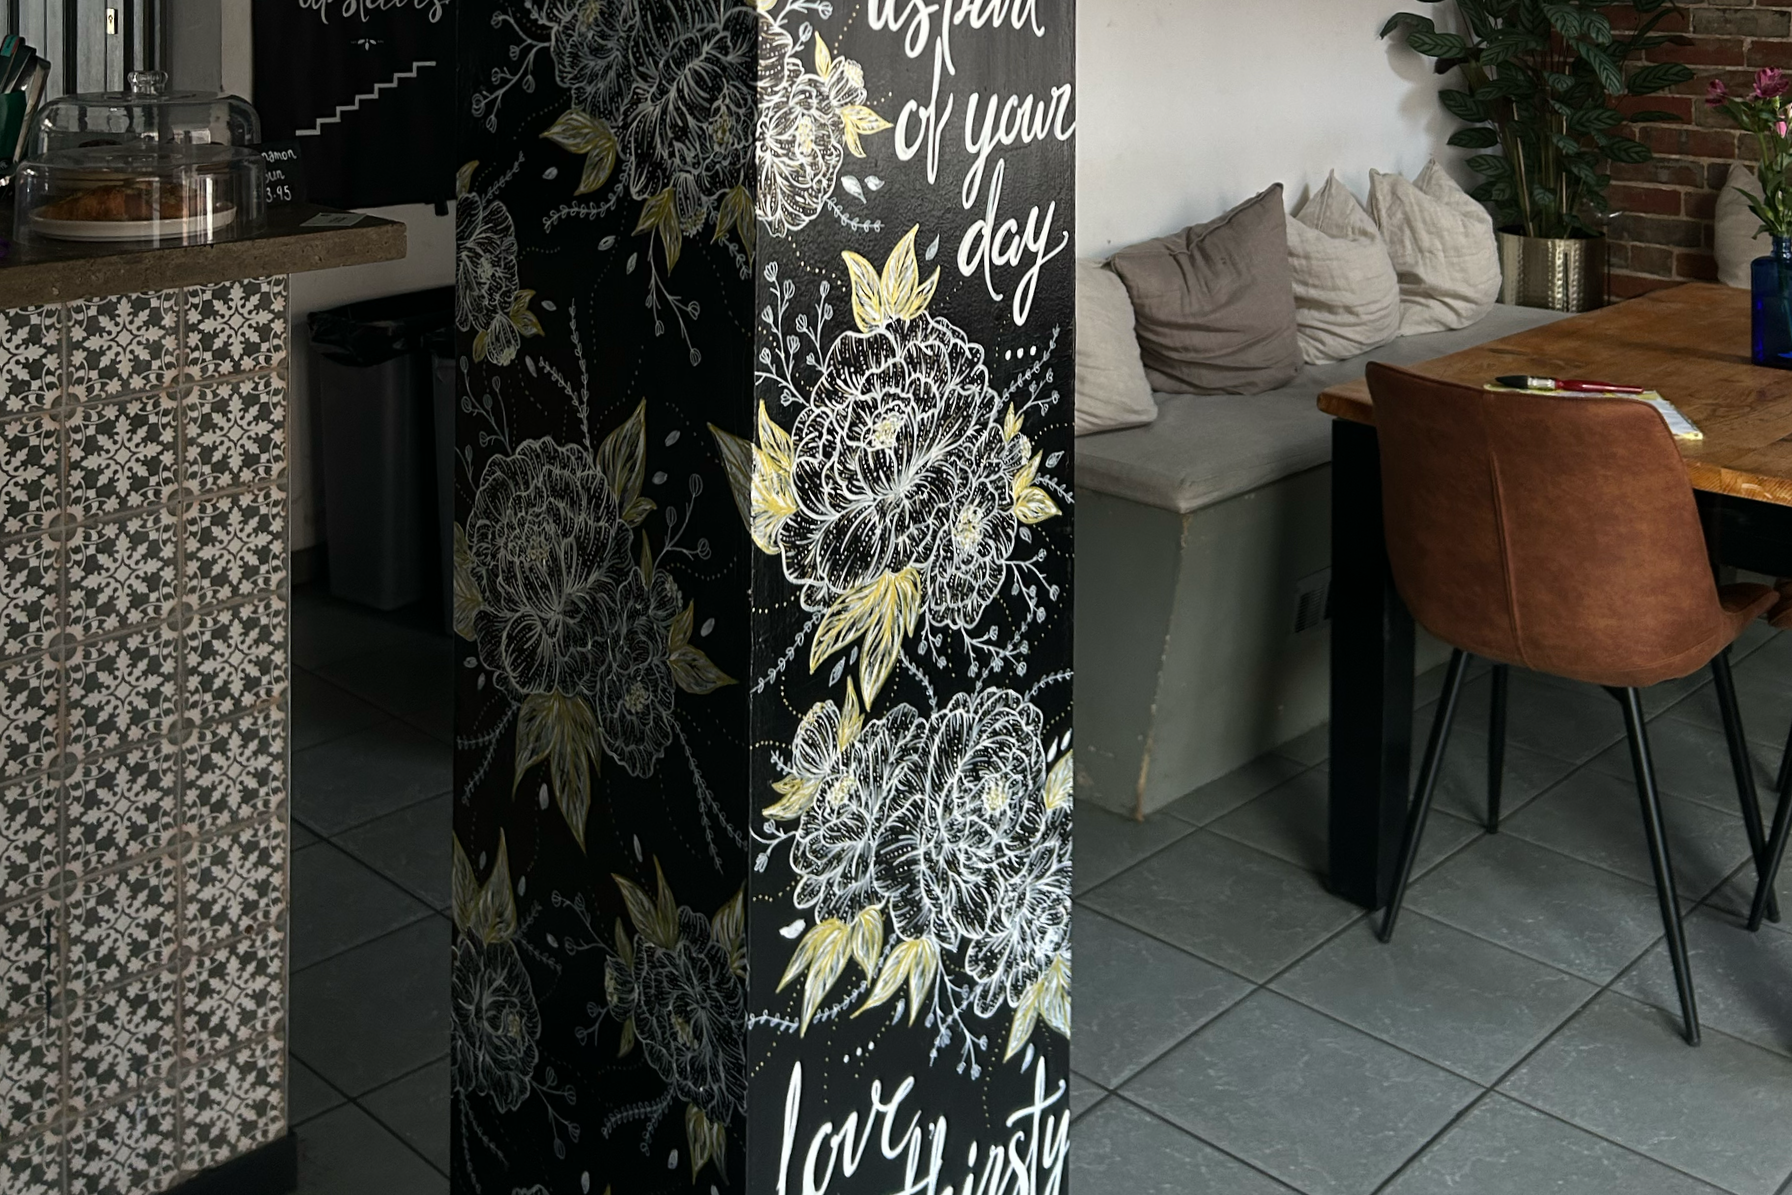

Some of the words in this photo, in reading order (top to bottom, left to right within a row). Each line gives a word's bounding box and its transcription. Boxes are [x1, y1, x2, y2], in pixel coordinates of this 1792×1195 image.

[894, 35, 955, 185] of
[963, 82, 1078, 210] your
[956, 157, 1070, 327] day
